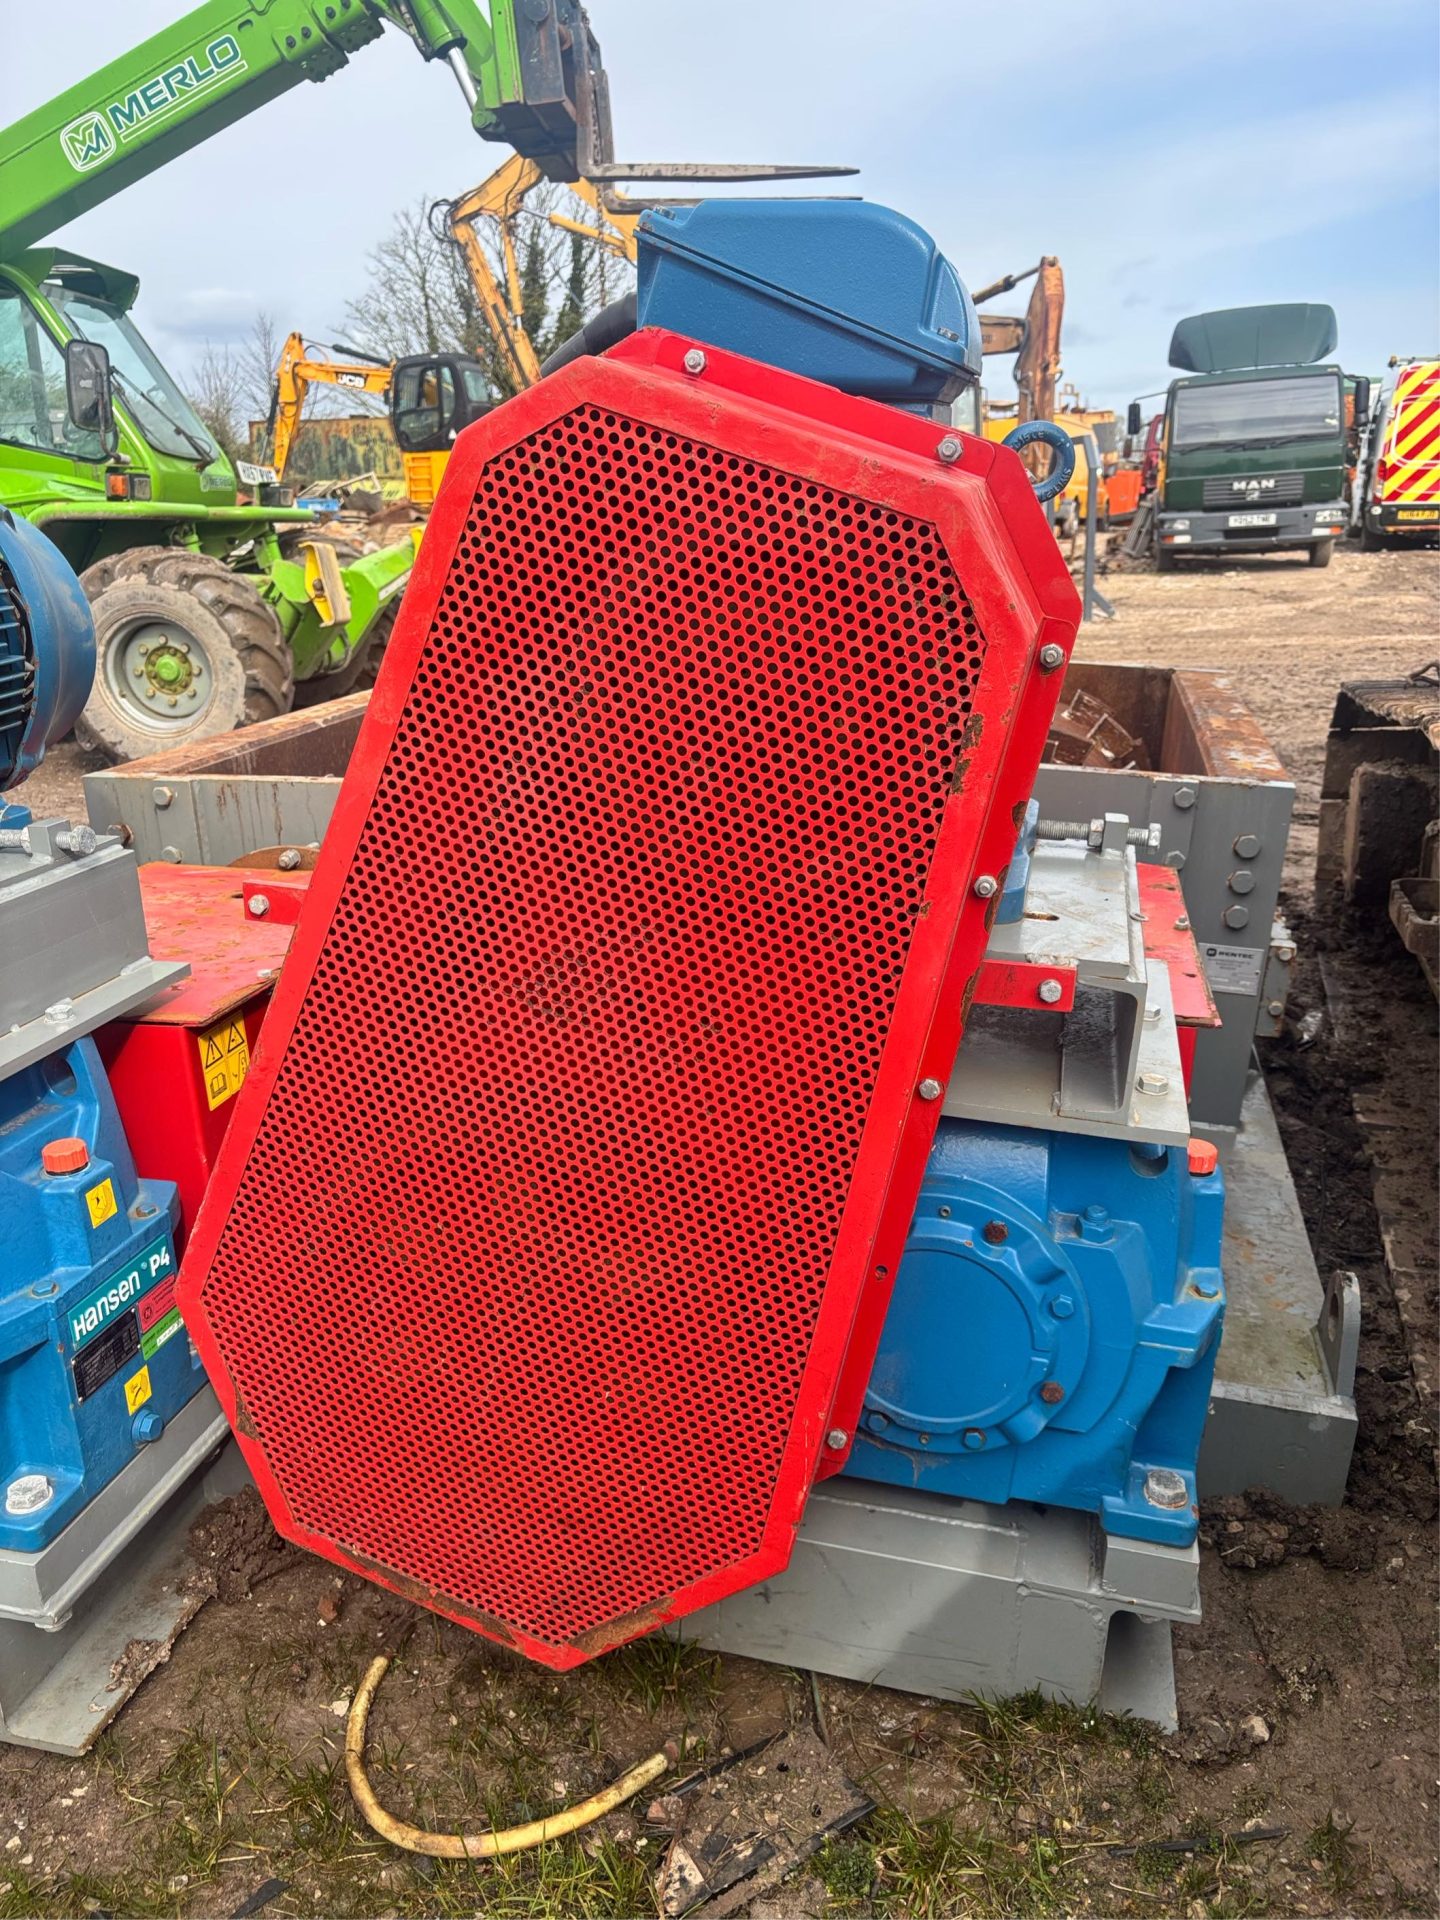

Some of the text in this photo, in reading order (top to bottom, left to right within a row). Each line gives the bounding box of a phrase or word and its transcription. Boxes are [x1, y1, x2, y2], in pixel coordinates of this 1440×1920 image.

[106, 34, 241, 132] MERLO
[337, 374, 365, 388] JCB
[1232, 479, 1275, 491] MAN
[73, 1270, 141, 1342] Hansen
[149, 1246, 171, 1277] P4
